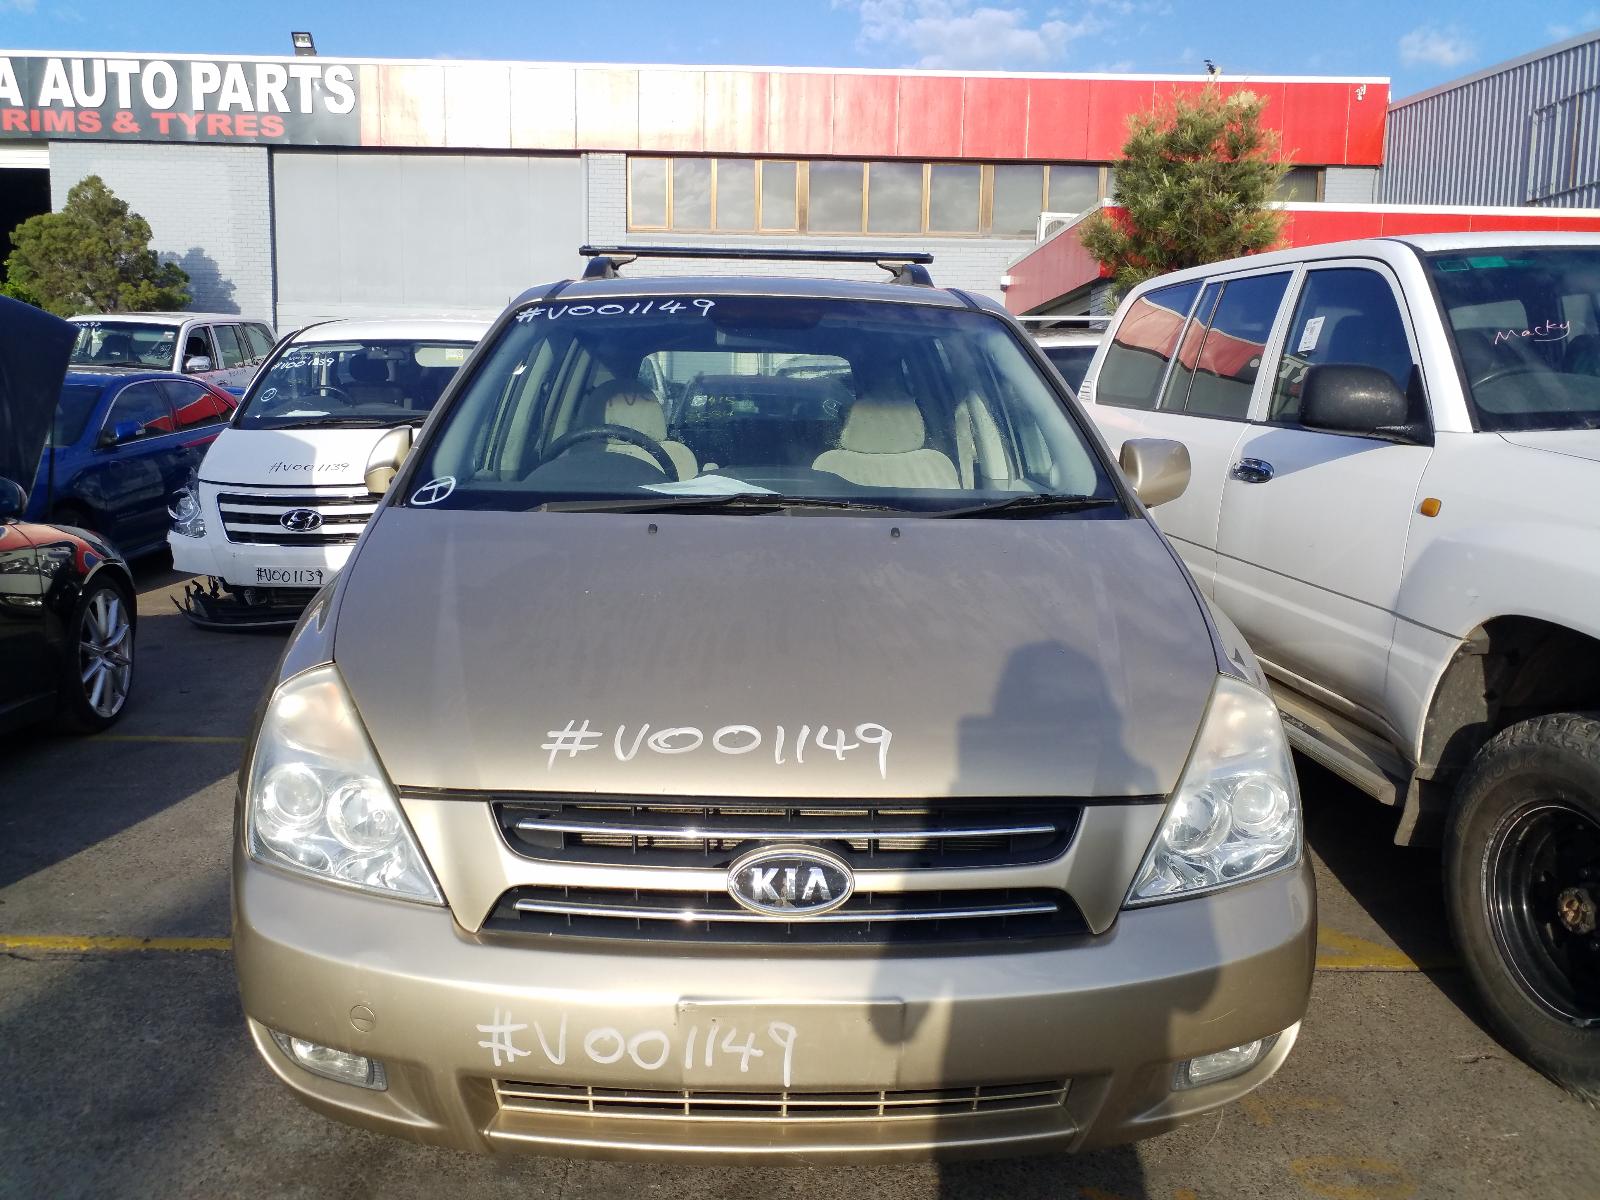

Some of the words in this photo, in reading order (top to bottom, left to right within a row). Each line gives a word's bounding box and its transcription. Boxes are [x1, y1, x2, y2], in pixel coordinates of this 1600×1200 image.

[38, 58, 178, 110] AUTO
[190, 61, 356, 115] PARTS
[3, 108, 102, 134] RIMS
[111, 110, 141, 135] &
[151, 112, 286, 138] TYRES
[516, 299, 716, 322] #V001149
[256, 567, 324, 585] #V001139
[541, 720, 892, 779] #V001149
[751, 866, 833, 900] KIA
[476, 1008, 798, 1087] #V001149
